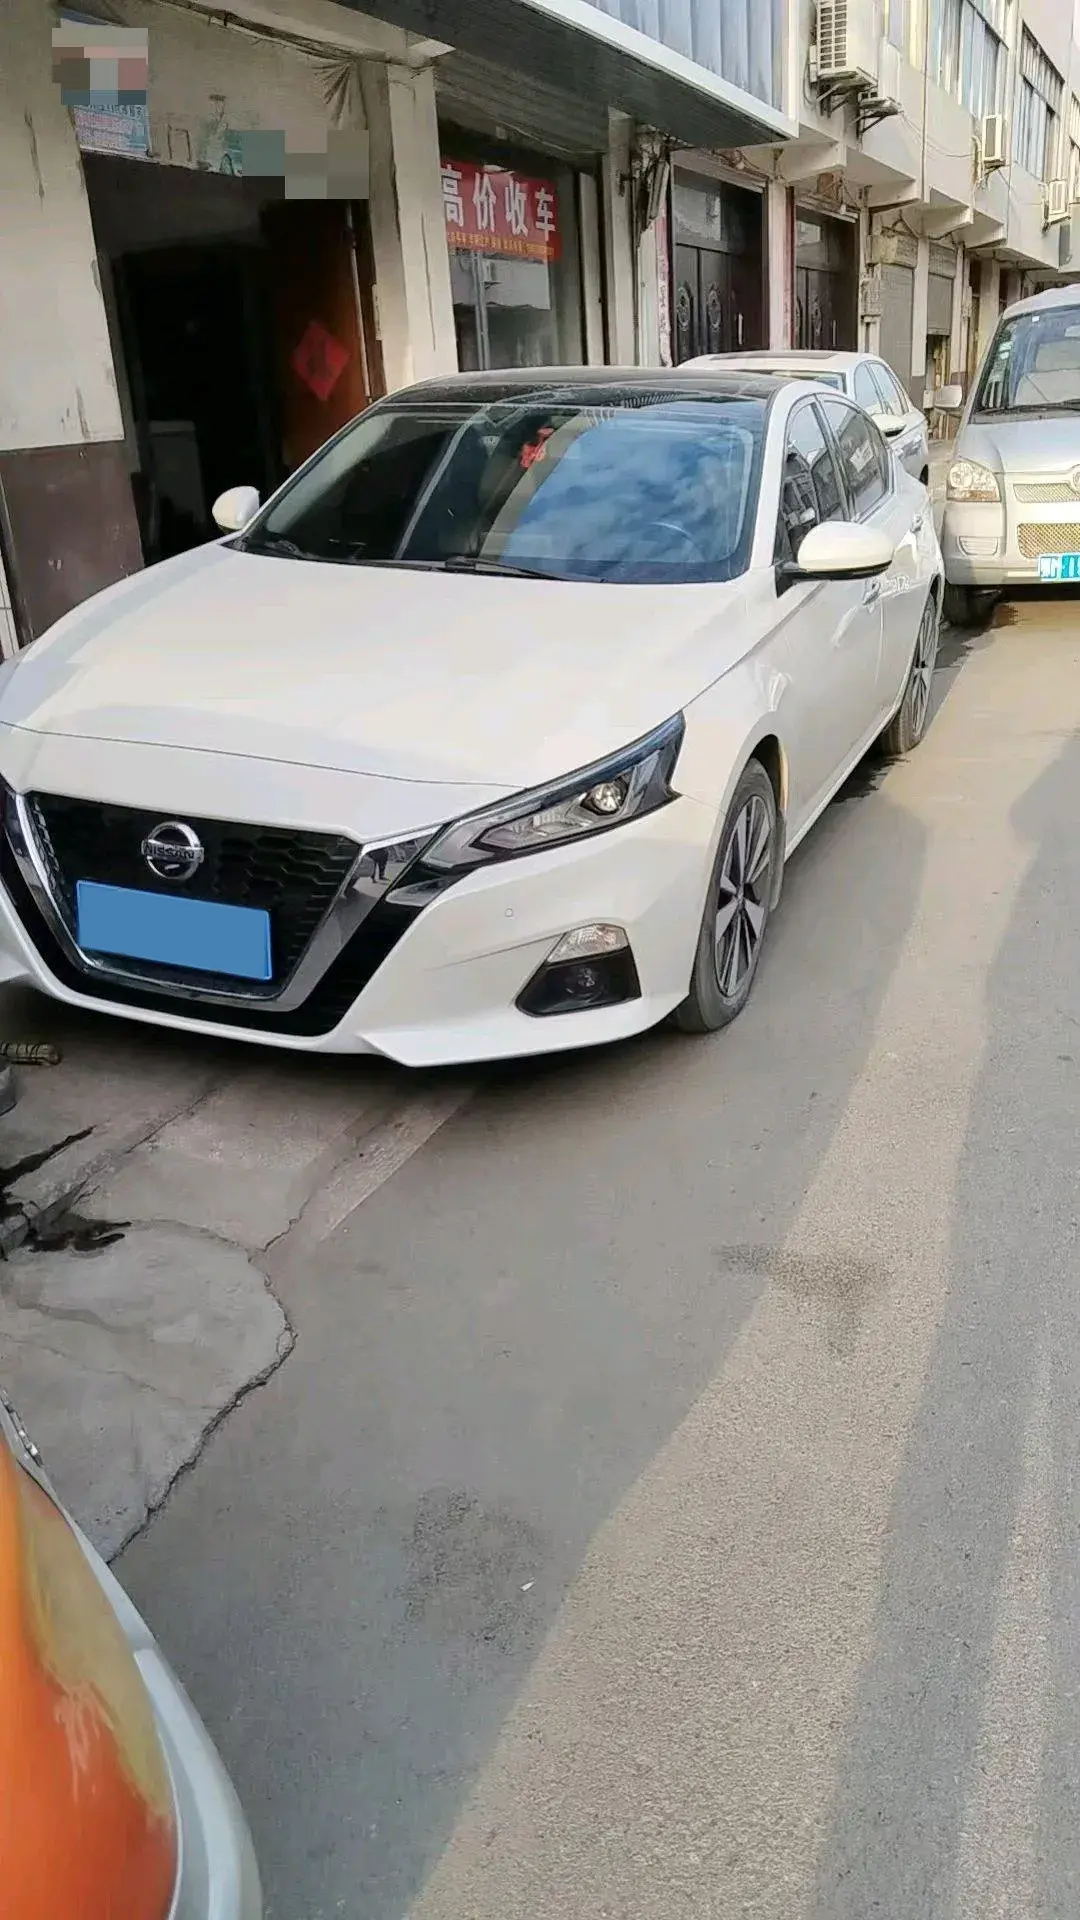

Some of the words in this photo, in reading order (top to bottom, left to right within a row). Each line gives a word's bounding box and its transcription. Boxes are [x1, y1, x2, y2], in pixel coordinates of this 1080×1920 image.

[441, 164, 556, 241] 高价收车
[143, 842, 197, 860] NISSAN
